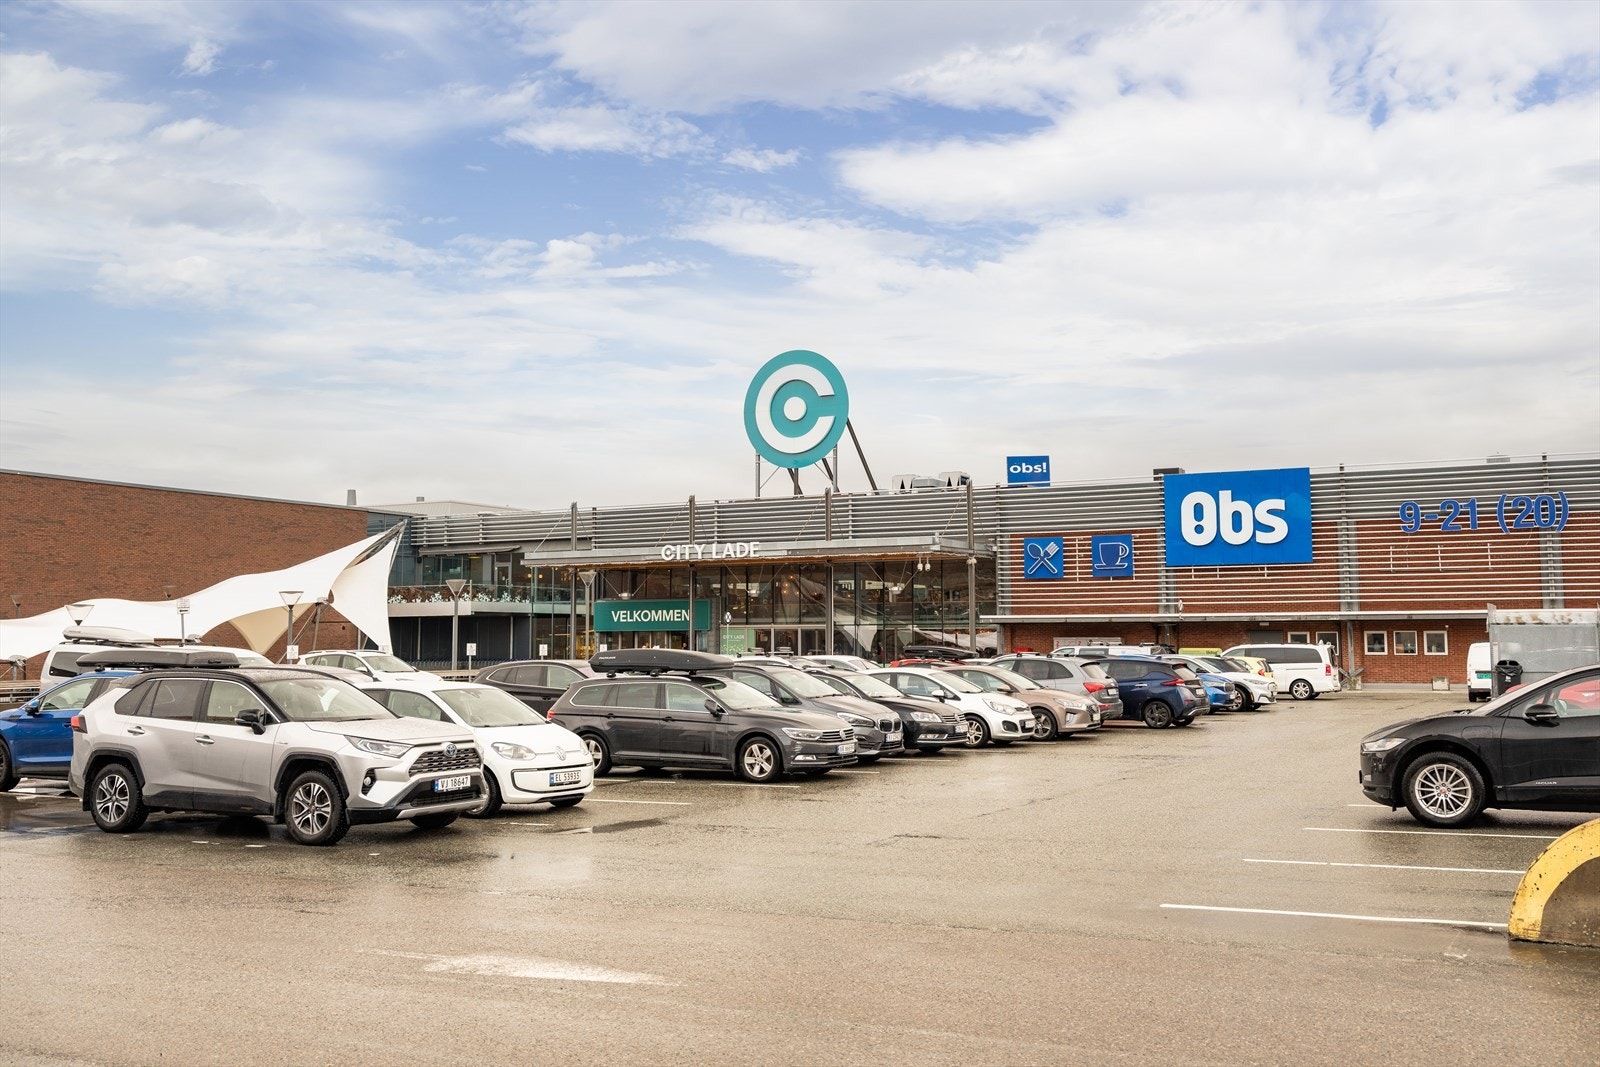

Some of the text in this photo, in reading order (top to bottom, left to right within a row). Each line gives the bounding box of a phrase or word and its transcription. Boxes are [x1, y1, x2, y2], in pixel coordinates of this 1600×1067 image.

[1009, 462, 1047, 474] obs!
[1181, 490, 1289, 547] Obs
[1399, 491, 1570, 534] 9-21 (20)
[661, 541, 760, 560] CITY LADE
[611, 609, 690, 622] VELKOMMEN
[450, 776, 469, 788] 18647
